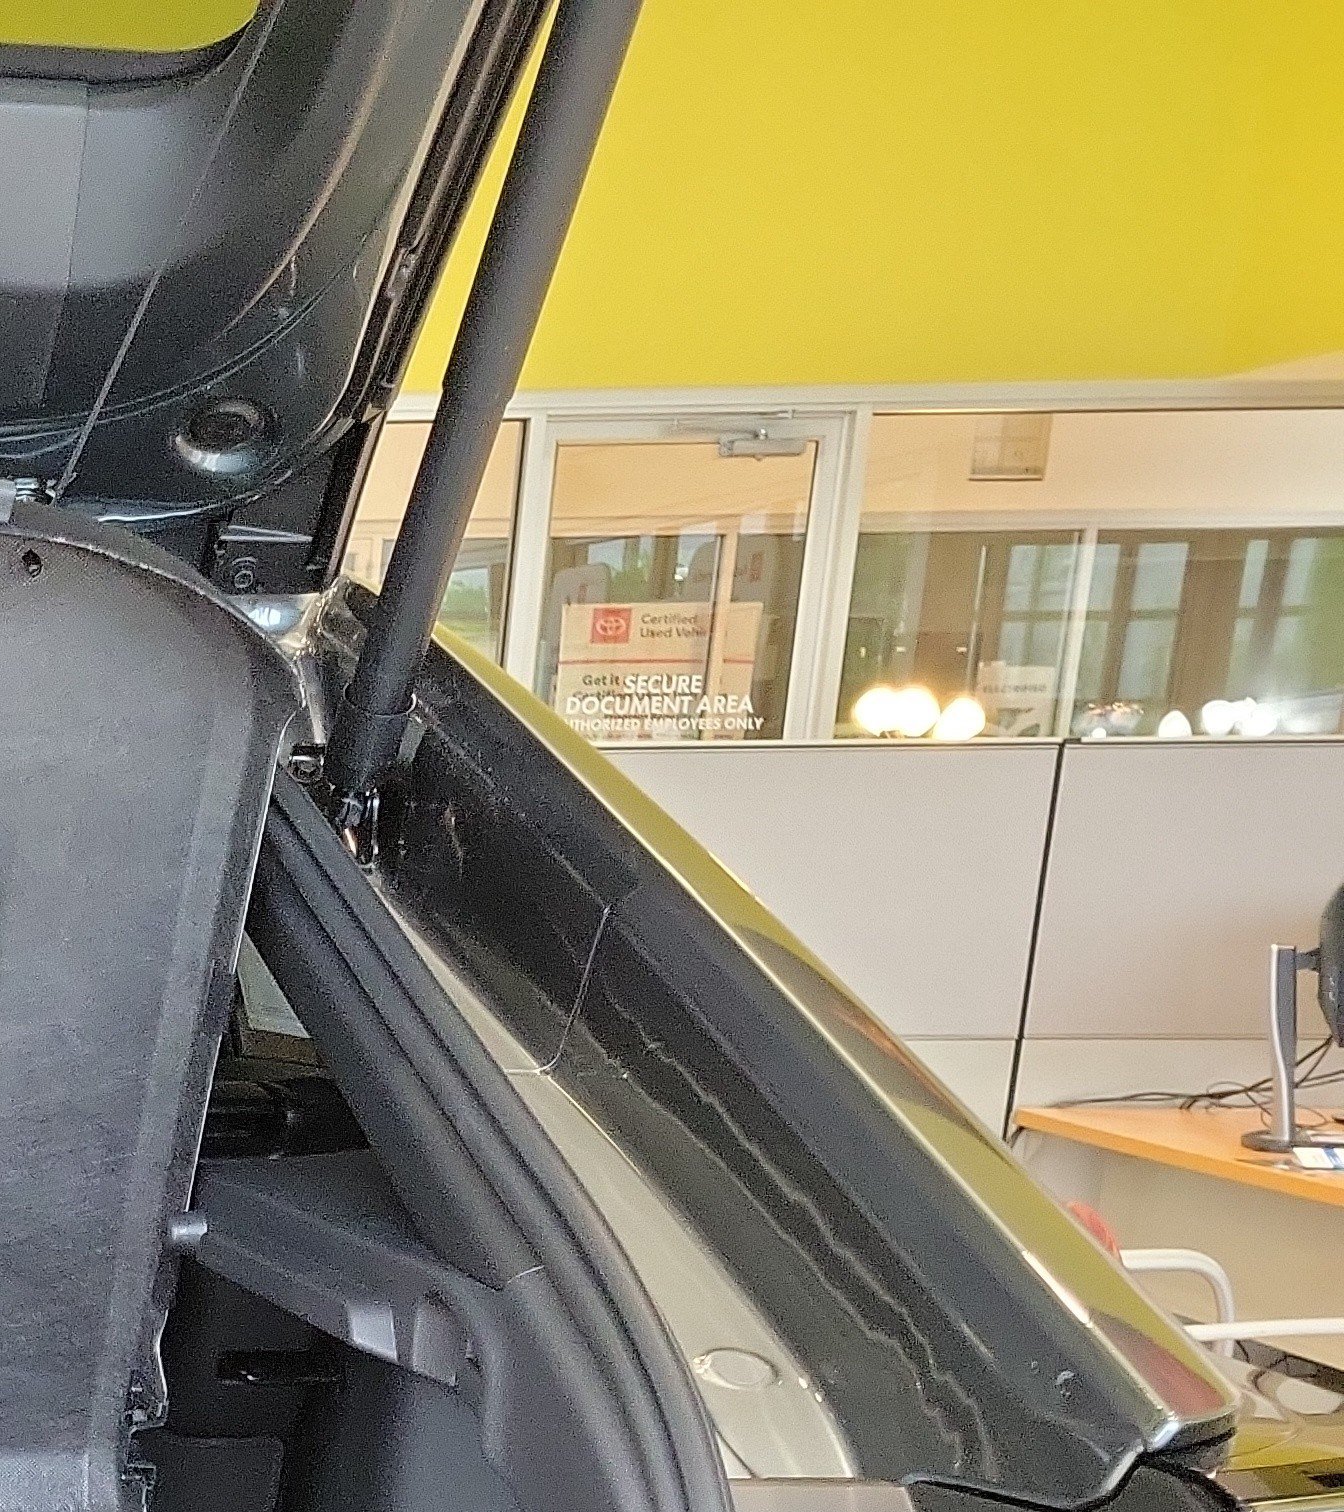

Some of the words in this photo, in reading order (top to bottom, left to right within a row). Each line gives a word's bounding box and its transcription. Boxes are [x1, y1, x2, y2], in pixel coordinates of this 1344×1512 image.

[639, 626, 672, 638] Used
[582, 675, 608, 686] Get
[623, 675, 702, 694] SECURE
[565, 695, 694, 715] DOCUMENT
[696, 695, 753, 714] AREA
[644, 717, 720, 731] EMPLOYEES
[724, 717, 764, 731] ONLY
